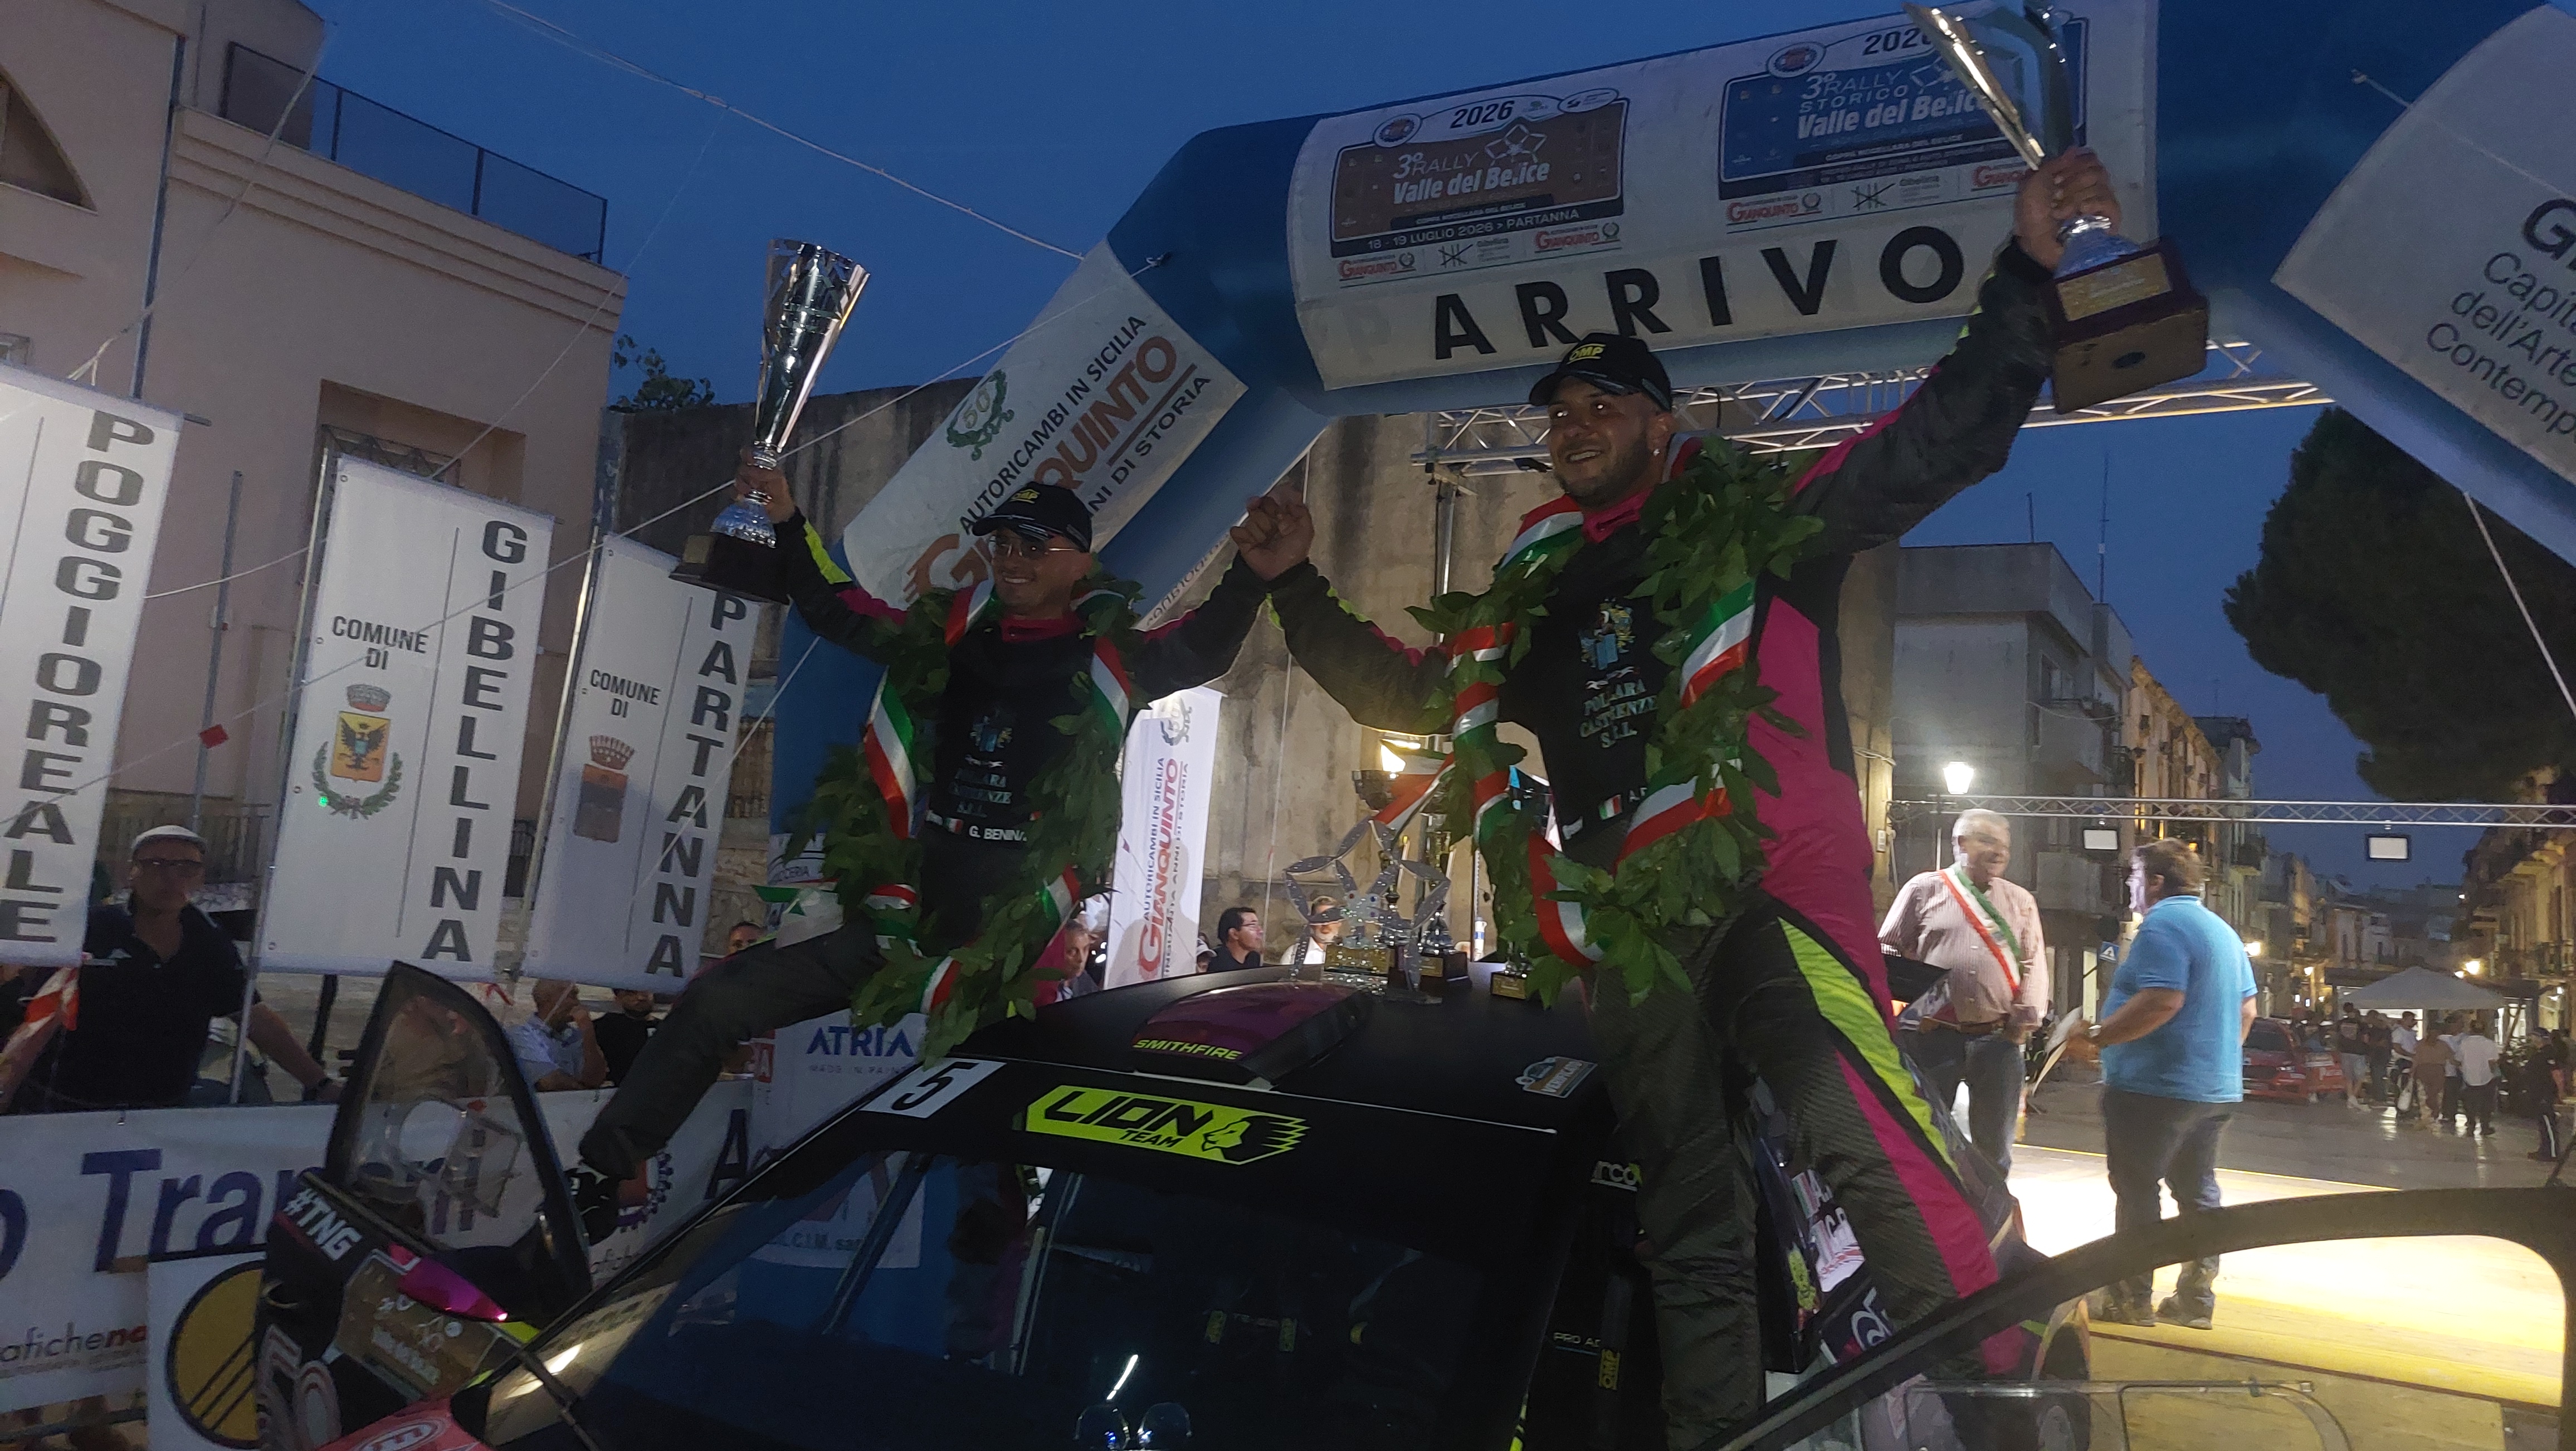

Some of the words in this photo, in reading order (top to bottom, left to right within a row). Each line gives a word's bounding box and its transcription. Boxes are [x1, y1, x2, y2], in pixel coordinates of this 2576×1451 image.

[1799, 85, 1909, 113] STORICO
[1823, 70, 1904, 96] RALLY
[1450, 101, 1515, 129] 2026
[1798, 108, 1860, 139] Valle
[1865, 99, 1909, 128] del
[1412, 152, 1479, 176] RALLY
[1393, 178, 1443, 204] Valle
[1447, 169, 1483, 195] del
[1409, 228, 1455, 244] LUGLIO
[1506, 208, 1580, 229] PARTANNA
[2522, 198, 2576, 271] G
[1434, 225, 1964, 360] ARRIVO
[1569, 343, 1607, 366] OMP
[2427, 323, 2576, 444] Contemp
[958, 398, 1069, 535] AUTORICAMBI
[1065, 381, 1092, 407] IN
[1088, 315, 1148, 383] SICILIA
[1110, 459, 1137, 486] DI
[1134, 372, 1213, 456] STORIA
[333, 616, 429, 655] COMUNE
[0, 410, 155, 942] POGGIOREALE
[365, 647, 389, 670] DI
[589, 669, 662, 706] COMUNE
[611, 698, 630, 719] DI
[421, 520, 528, 962] GIBELLINA
[645, 591, 747, 978] PARTANNA
[1139, 758, 1178, 972] GIANQUINTO
[806, 1026, 915, 1058] ATRIA
[1131, 1039, 1243, 1060] SMITHFIRE
[891, 1062, 979, 1112] 5
[1045, 1090, 1213, 1137] LION
[1116, 1128, 1182, 1148] TEAM
[282, 1187, 363, 1261] #TNG
